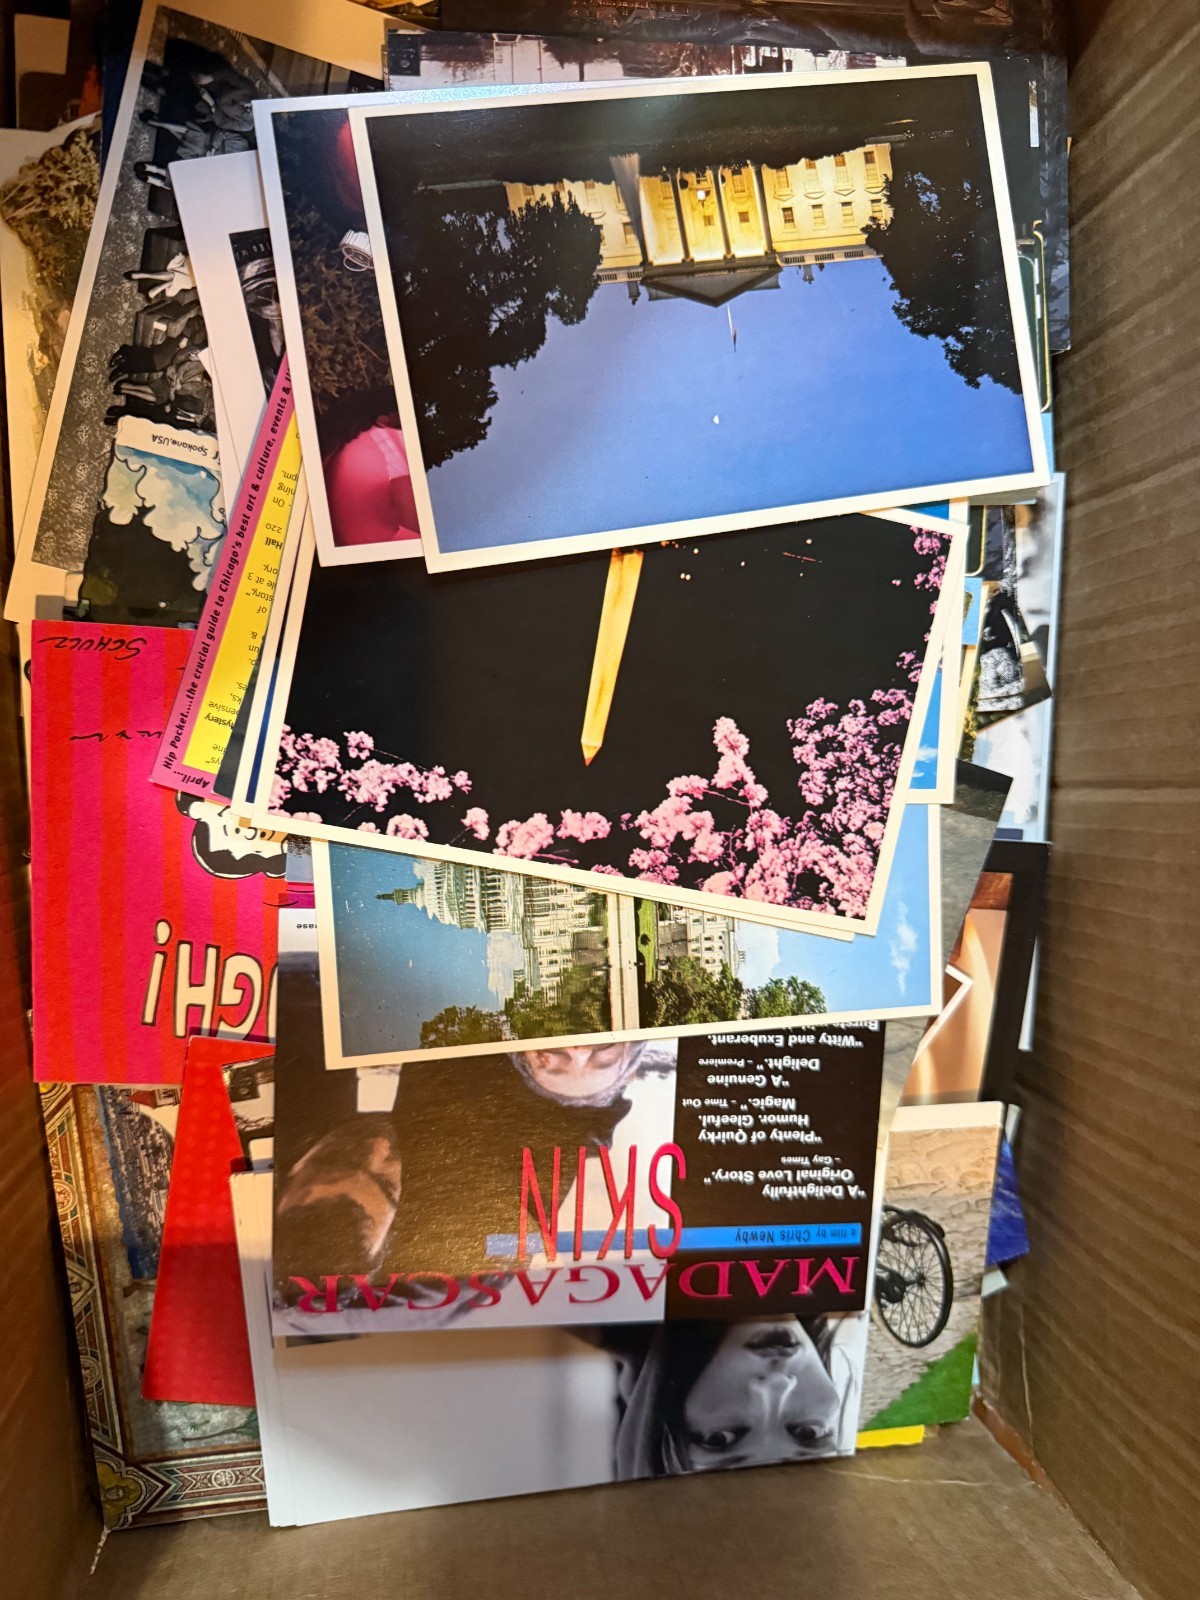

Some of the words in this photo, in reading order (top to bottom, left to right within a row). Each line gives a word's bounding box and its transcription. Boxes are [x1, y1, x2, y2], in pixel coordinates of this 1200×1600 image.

[273, 497, 284, 507] On
[266, 523, 282, 533] 220
[265, 537, 282, 550] Hall
[248, 572, 254, 580] 3
[164, 752, 177, 769] Hip
[194, 642, 210, 679] crucial
[206, 610, 220, 641] guide
[215, 596, 225, 607] to
[220, 541, 241, 592] Chicago's
[236, 514, 250, 538] best
[246, 494, 256, 511] art
[251, 484, 260, 492] &
[256, 438, 275, 479] culture,
[270, 397, 286, 433] events
[142, 919, 278, 1044] GH!
[708, 1034, 784, 1048] Exuberant.
[788, 1034, 815, 1046] and
[698, 1058, 745, 1067] Premiere
[707, 1074, 766, 1087] Genuine
[682, 1098, 701, 1108] Out
[704, 1098, 728, 1108] Time
[698, 1114, 754, 1127] Gleeful.
[758, 1114, 809, 1127] Humor.
[698, 1128, 747, 1144] Quirky
[750, 1130, 766, 1144] of
[781, 1156, 810, 1165] Times
[813, 1154, 832, 1165] Gay
[758, 1170, 792, 1183] Love
[797, 1167, 853, 1182] Original
[762, 1184, 843, 1199] Delightfully
[518, 1142, 686, 1261] SKIN
[735, 1229, 774, 1244] Newby
[780, 1230, 810, 1242] Chris
[816, 1227, 826, 1239] by
[288, 1256, 861, 1314] MADAGASCAR
